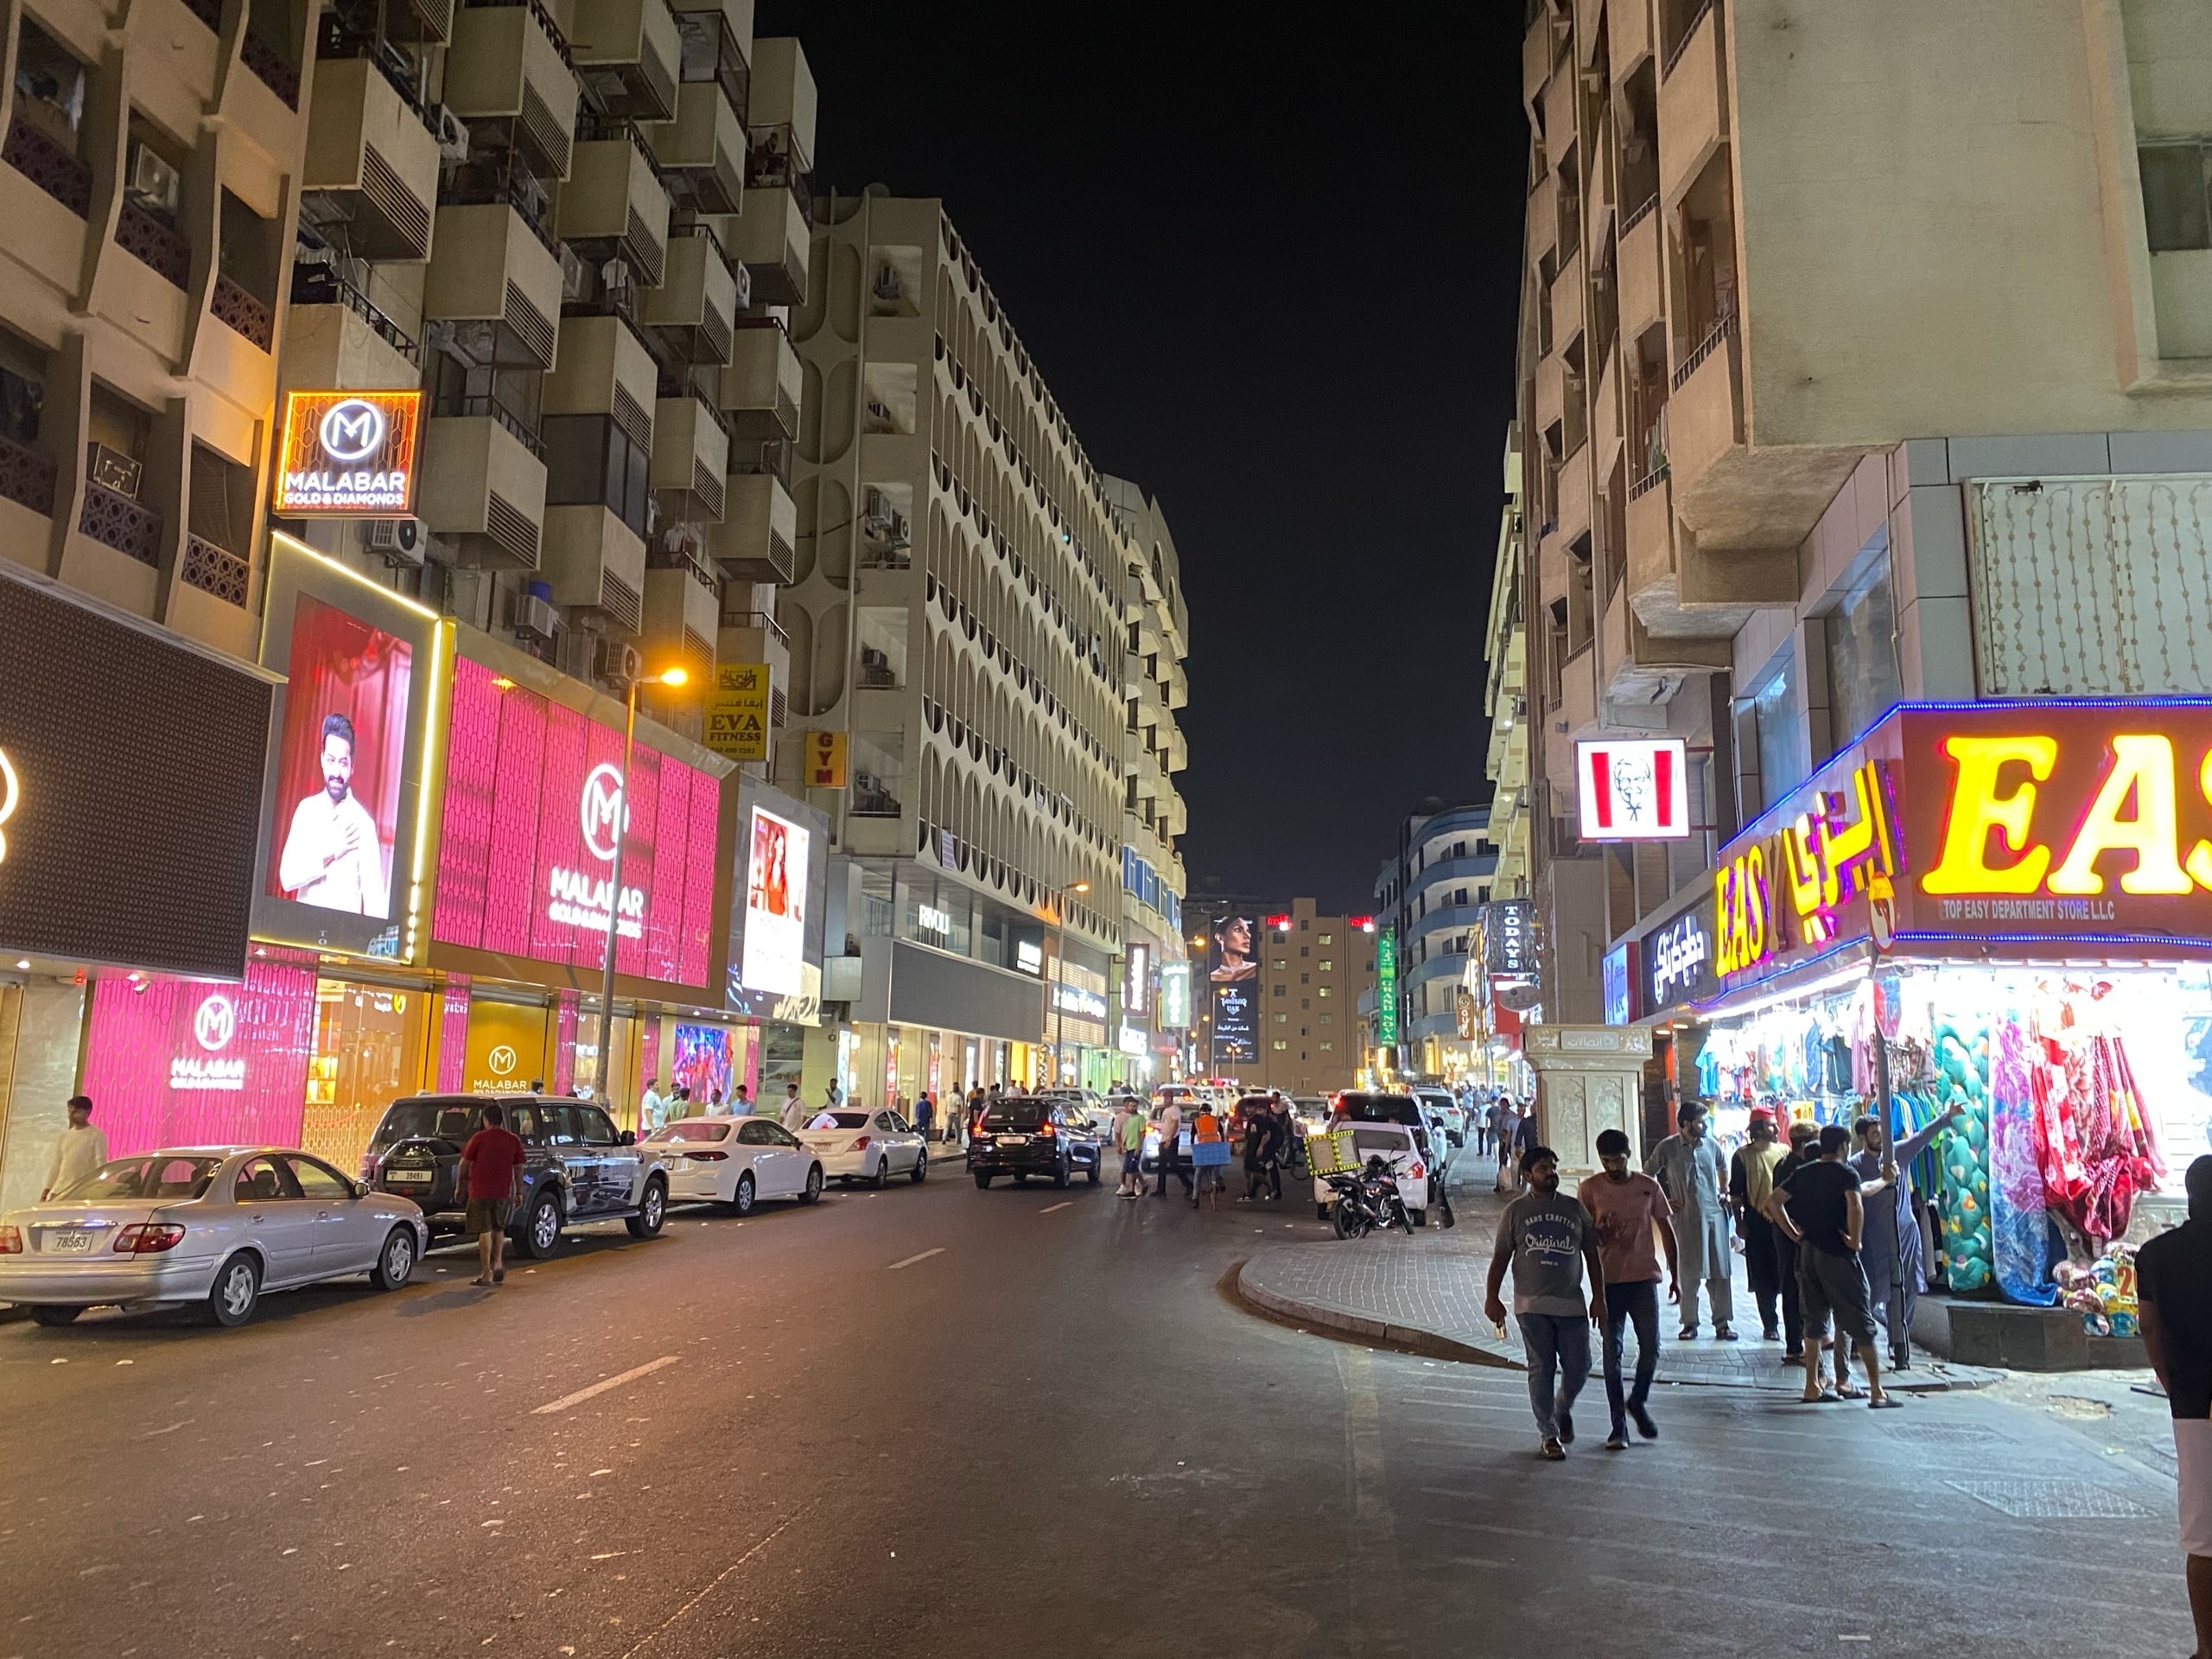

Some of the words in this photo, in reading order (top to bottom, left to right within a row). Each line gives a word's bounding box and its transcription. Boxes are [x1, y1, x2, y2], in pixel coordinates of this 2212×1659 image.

[285, 472, 406, 492] MALABAR
[283, 493, 321, 505] GOLD
[333, 493, 404, 505] DIAMONDS
[709, 714, 761, 731] EVA
[709, 732, 761, 741] FITNESS
[815, 732, 834, 784] GYM
[1922, 734, 2212, 894] EA
[1715, 833, 1781, 978] EASY
[1943, 899, 1962, 918] TOP
[1964, 899, 1989, 918] EASY
[1992, 899, 2054, 919] DEPARTMENT
[2057, 900, 2089, 920] STORE
[1504, 906, 1521, 969] TODAYS
[1382, 981, 1394, 1011] GRAND
[1382, 1014, 1395, 1040] NOVA
[474, 1079, 527, 1089] MALABAR
[1524, 1214, 1542, 1226] HAND
[1545, 1213, 1575, 1230] CRAFTED
[56, 1236, 86, 1248] 78563
[1525, 1233, 1571, 1254] Original
[2117, 1266, 2139, 1297] 2
